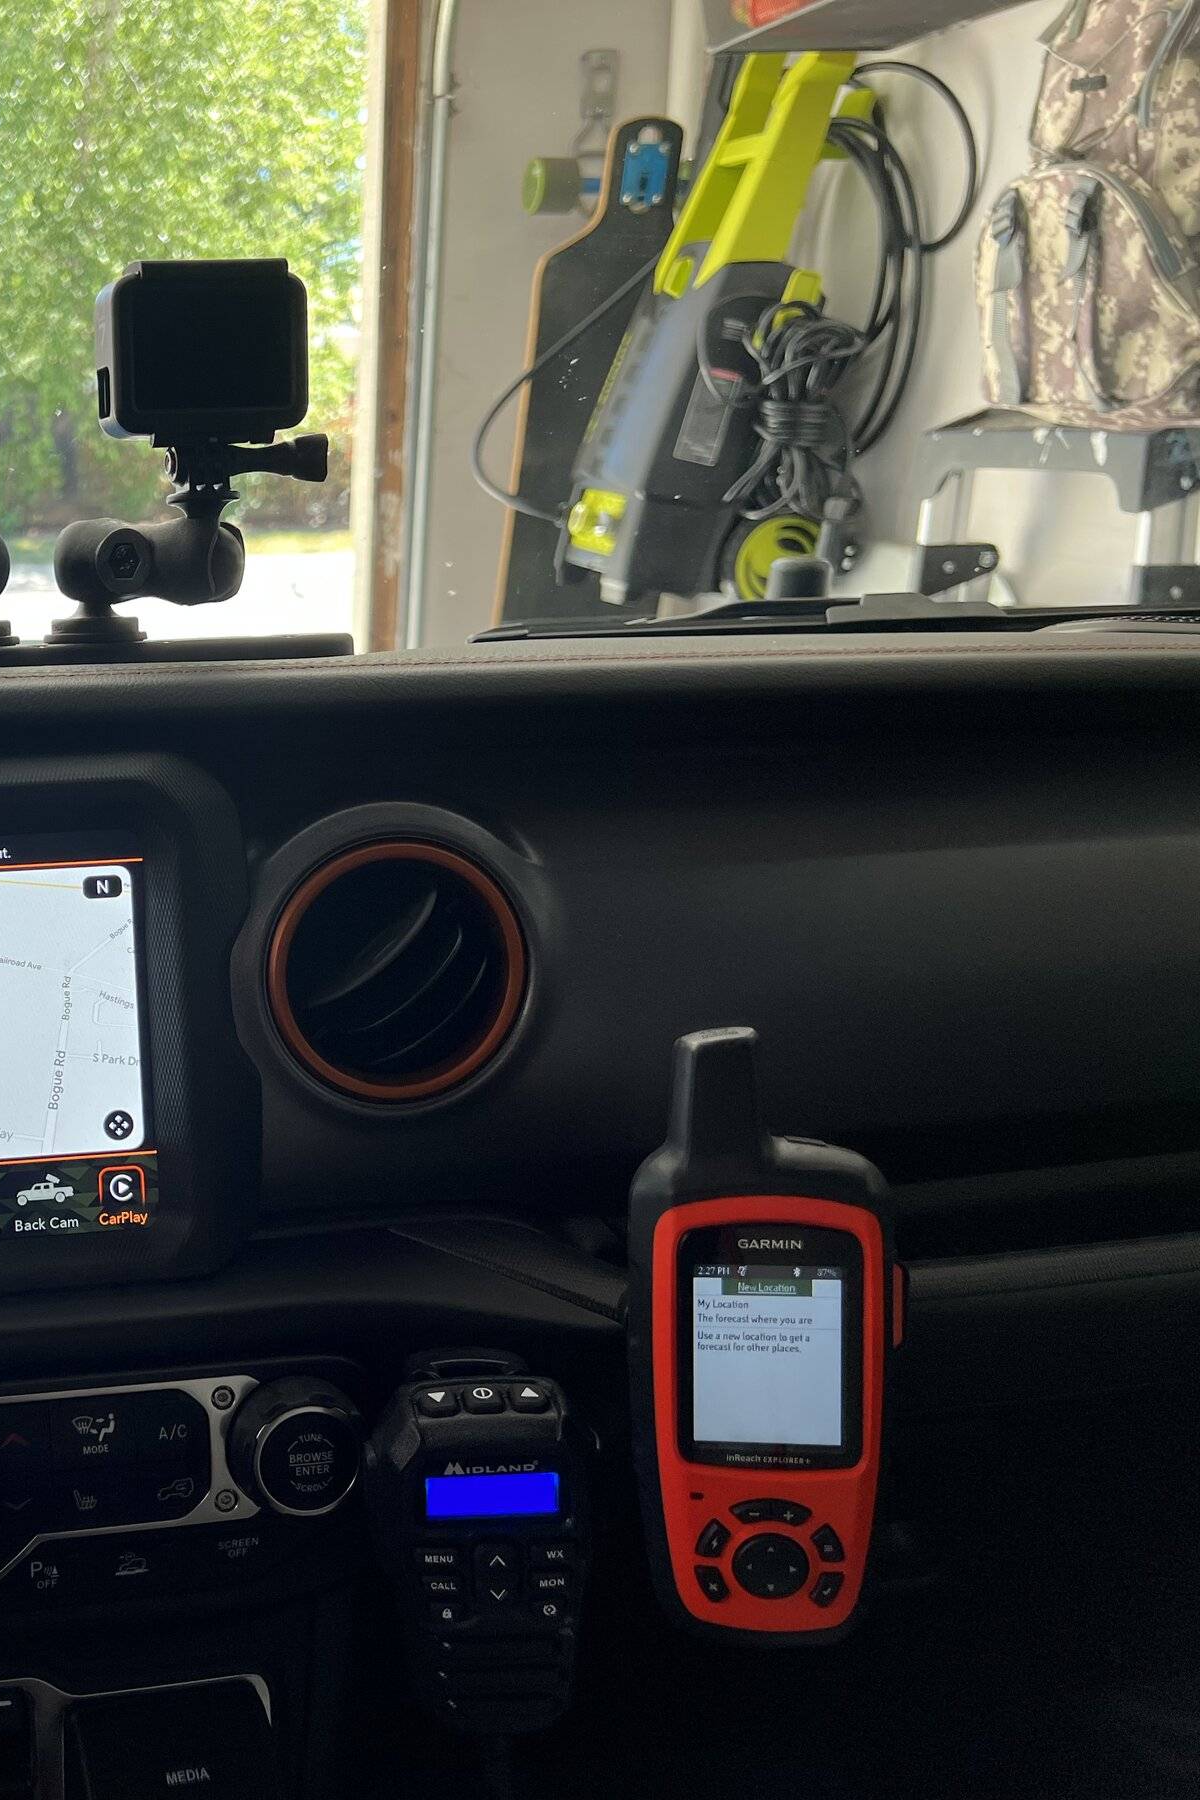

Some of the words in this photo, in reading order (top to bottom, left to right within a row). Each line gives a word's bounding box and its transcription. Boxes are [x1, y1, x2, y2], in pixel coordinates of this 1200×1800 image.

[96, 879, 110, 895] N
[109, 922, 129, 940] Bogue
[27, 960, 43, 971] Ave
[61, 975, 71, 989] Rd
[61, 989, 71, 1021] Bogue
[99, 990, 135, 1010] Hastings
[54, 1049, 67, 1068] Rd
[101, 1053, 126, 1066] Park
[47, 1069, 64, 1111] Bogue
[14, 1217, 47, 1233] Back
[49, 1215, 80, 1231] Cam
[99, 1210, 149, 1227] CarPlay
[737, 1238, 802, 1250] GARMIN
[697, 1265, 716, 1276] 2:27
[738, 1281, 756, 1292] New
[758, 1282, 796, 1293] Location
[697, 1299, 710, 1310] My
[712, 1300, 749, 1310] Location
[697, 1312, 714, 1323] The
[715, 1313, 750, 1324] forecast
[751, 1314, 778, 1325] where
[780, 1317, 797, 1327] you
[798, 1317, 813, 1326] are
[697, 1330, 713, 1341] Use
[722, 1333, 741, 1341] new
[742, 1331, 777, 1342] location
[779, 1333, 788, 1342] to
[789, 1334, 804, 1345] get
[696, 1343, 732, 1352] forecast
[733, 1343, 746, 1352] for
[747, 1343, 770, 1353] other
[771, 1345, 802, 1355] places.
[158, 1423, 188, 1441] A/C
[298, 1432, 323, 1445] TUNE
[82, 1443, 110, 1455] MODE
[288, 1450, 334, 1464] BROWSE
[726, 1453, 761, 1463] inReach
[295, 1464, 330, 1477] ENTER
[443, 1461, 538, 1476] MIDLAND
[295, 1479, 328, 1493] SCROLL
[216, 1536, 260, 1551] SCREEN
[227, 1548, 249, 1560] OFF
[424, 1554, 454, 1564] MENU
[546, 1549, 565, 1560] WX
[36, 1578, 58, 1590] OFF
[430, 1581, 457, 1591] CALL
[539, 1577, 566, 1588] MON
[165, 1766, 211, 1786] MEDIA
